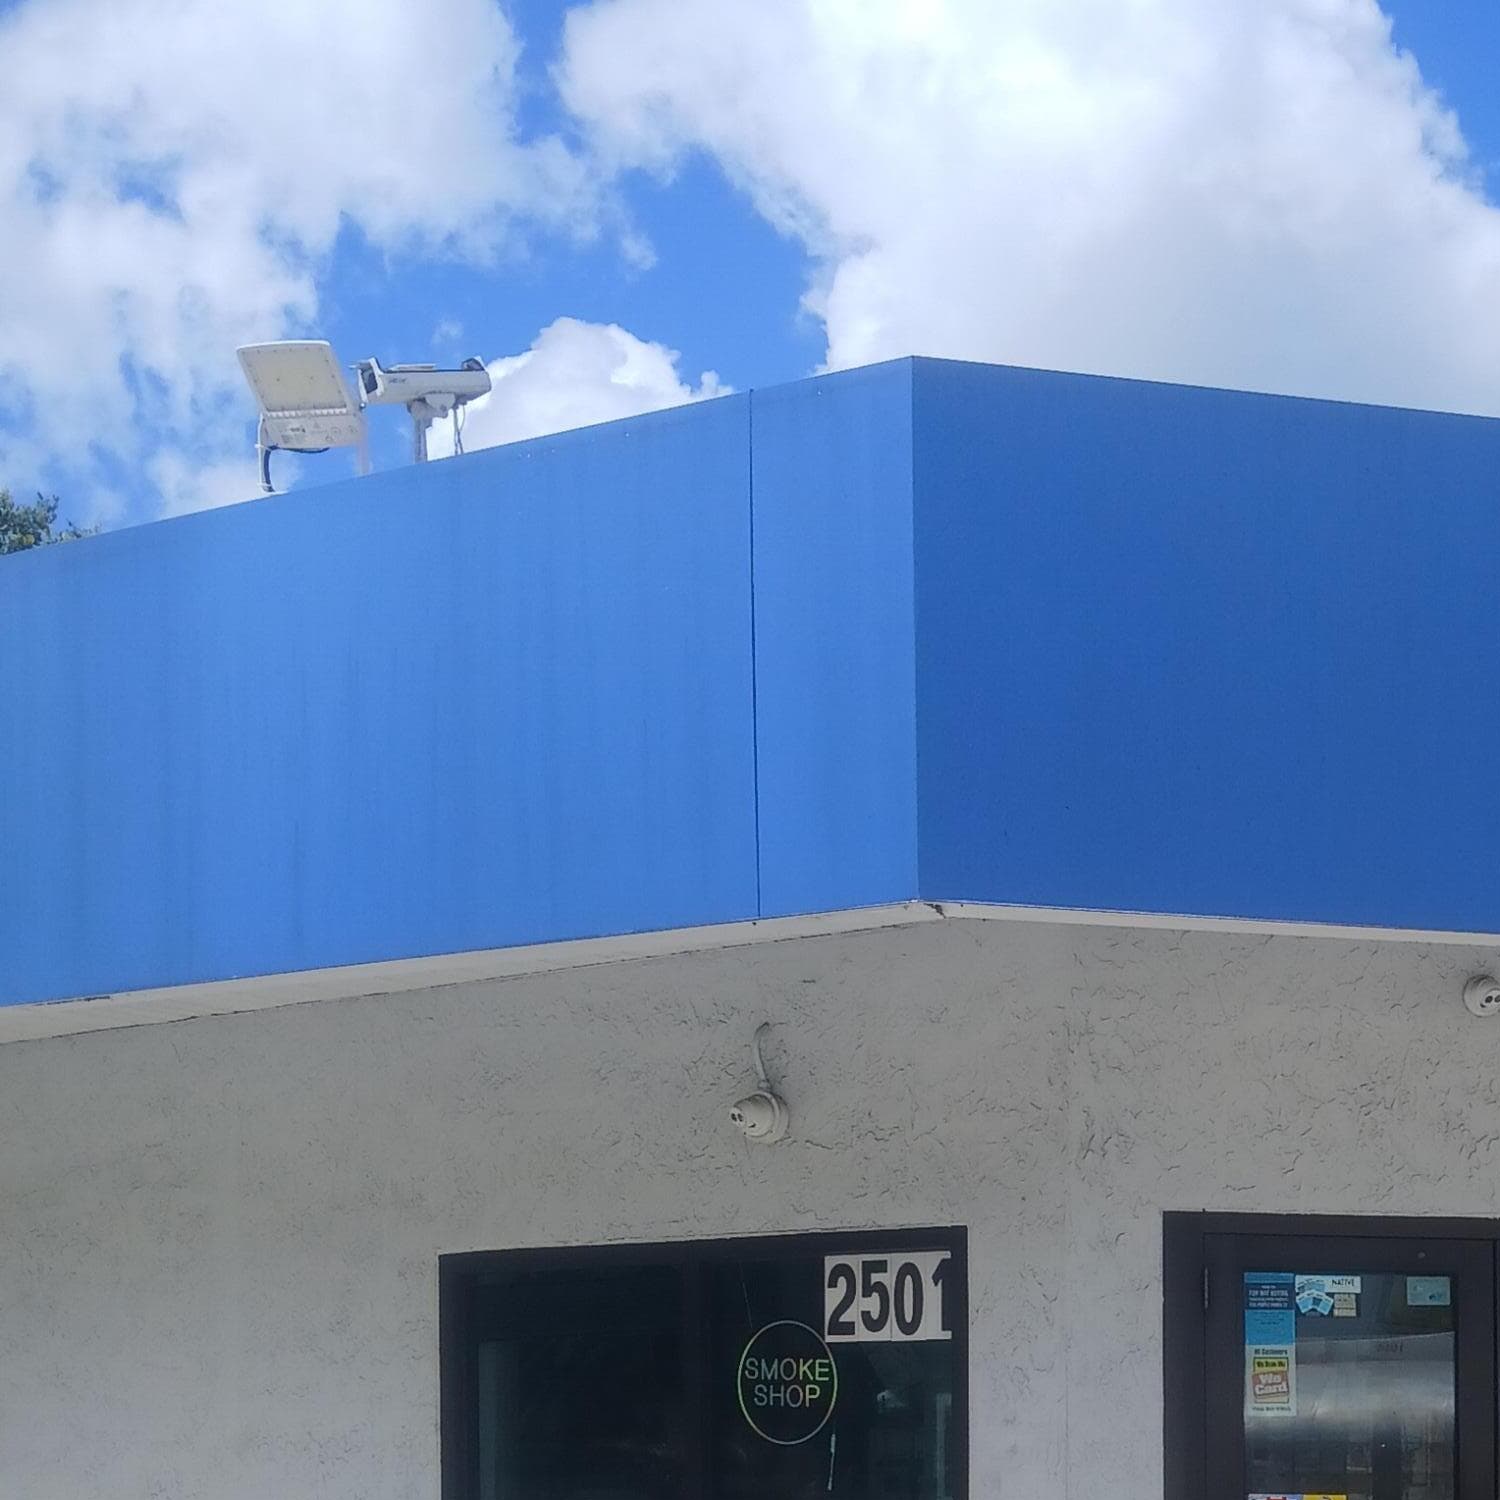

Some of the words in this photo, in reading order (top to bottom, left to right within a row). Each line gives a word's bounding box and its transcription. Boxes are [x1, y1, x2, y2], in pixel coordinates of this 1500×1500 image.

[827, 1258, 952, 1336] 2501
[745, 1358, 830, 1381] SMOKE
[754, 1384, 821, 1408] SHOP
[1254, 1382, 1288, 1396] Card
